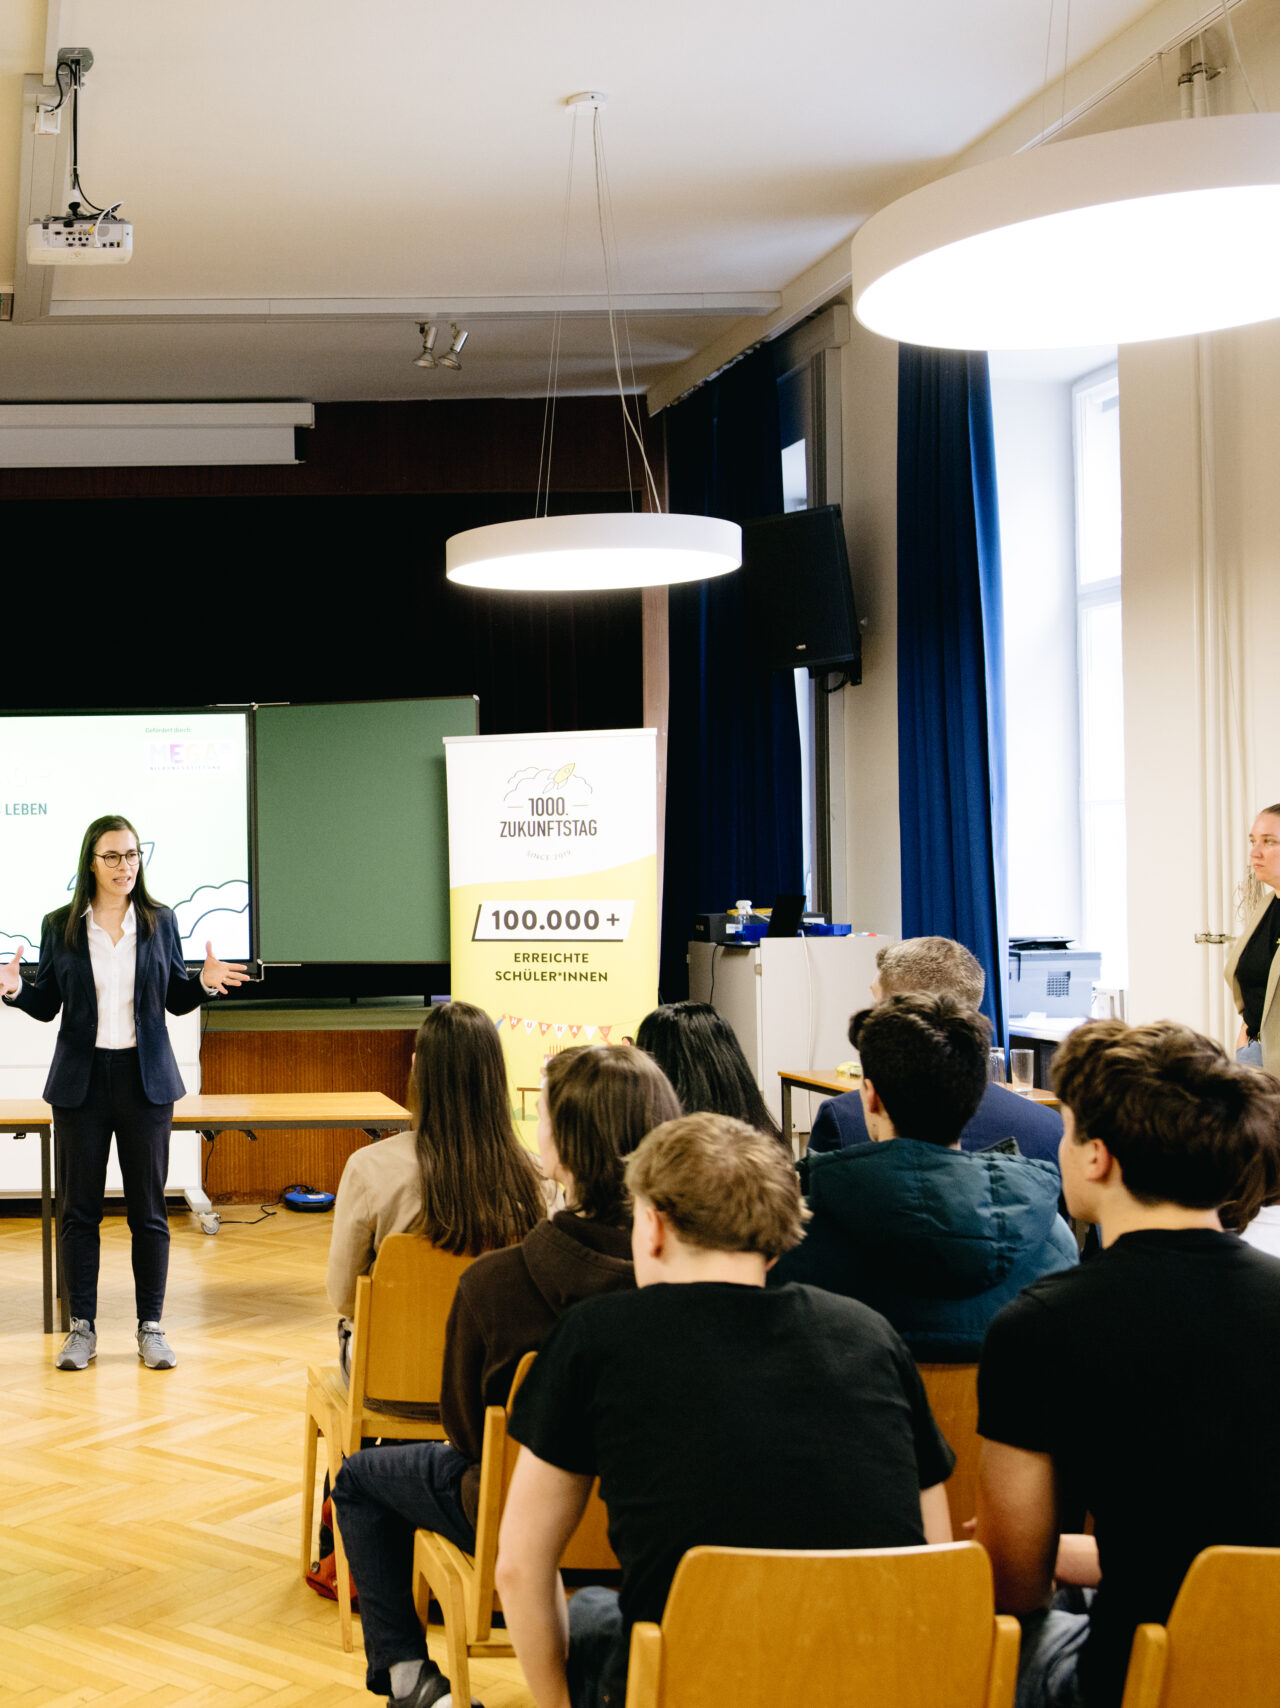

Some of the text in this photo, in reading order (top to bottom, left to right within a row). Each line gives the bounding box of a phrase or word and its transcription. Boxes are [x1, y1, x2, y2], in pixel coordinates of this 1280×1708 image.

[4, 802, 48, 816] LEBEN
[527, 796, 569, 817] 1000.
[499, 819, 598, 838] ZUKUNFTSTAG
[491, 909, 601, 932] 100.000
[513, 951, 590, 964] ERREICHTE
